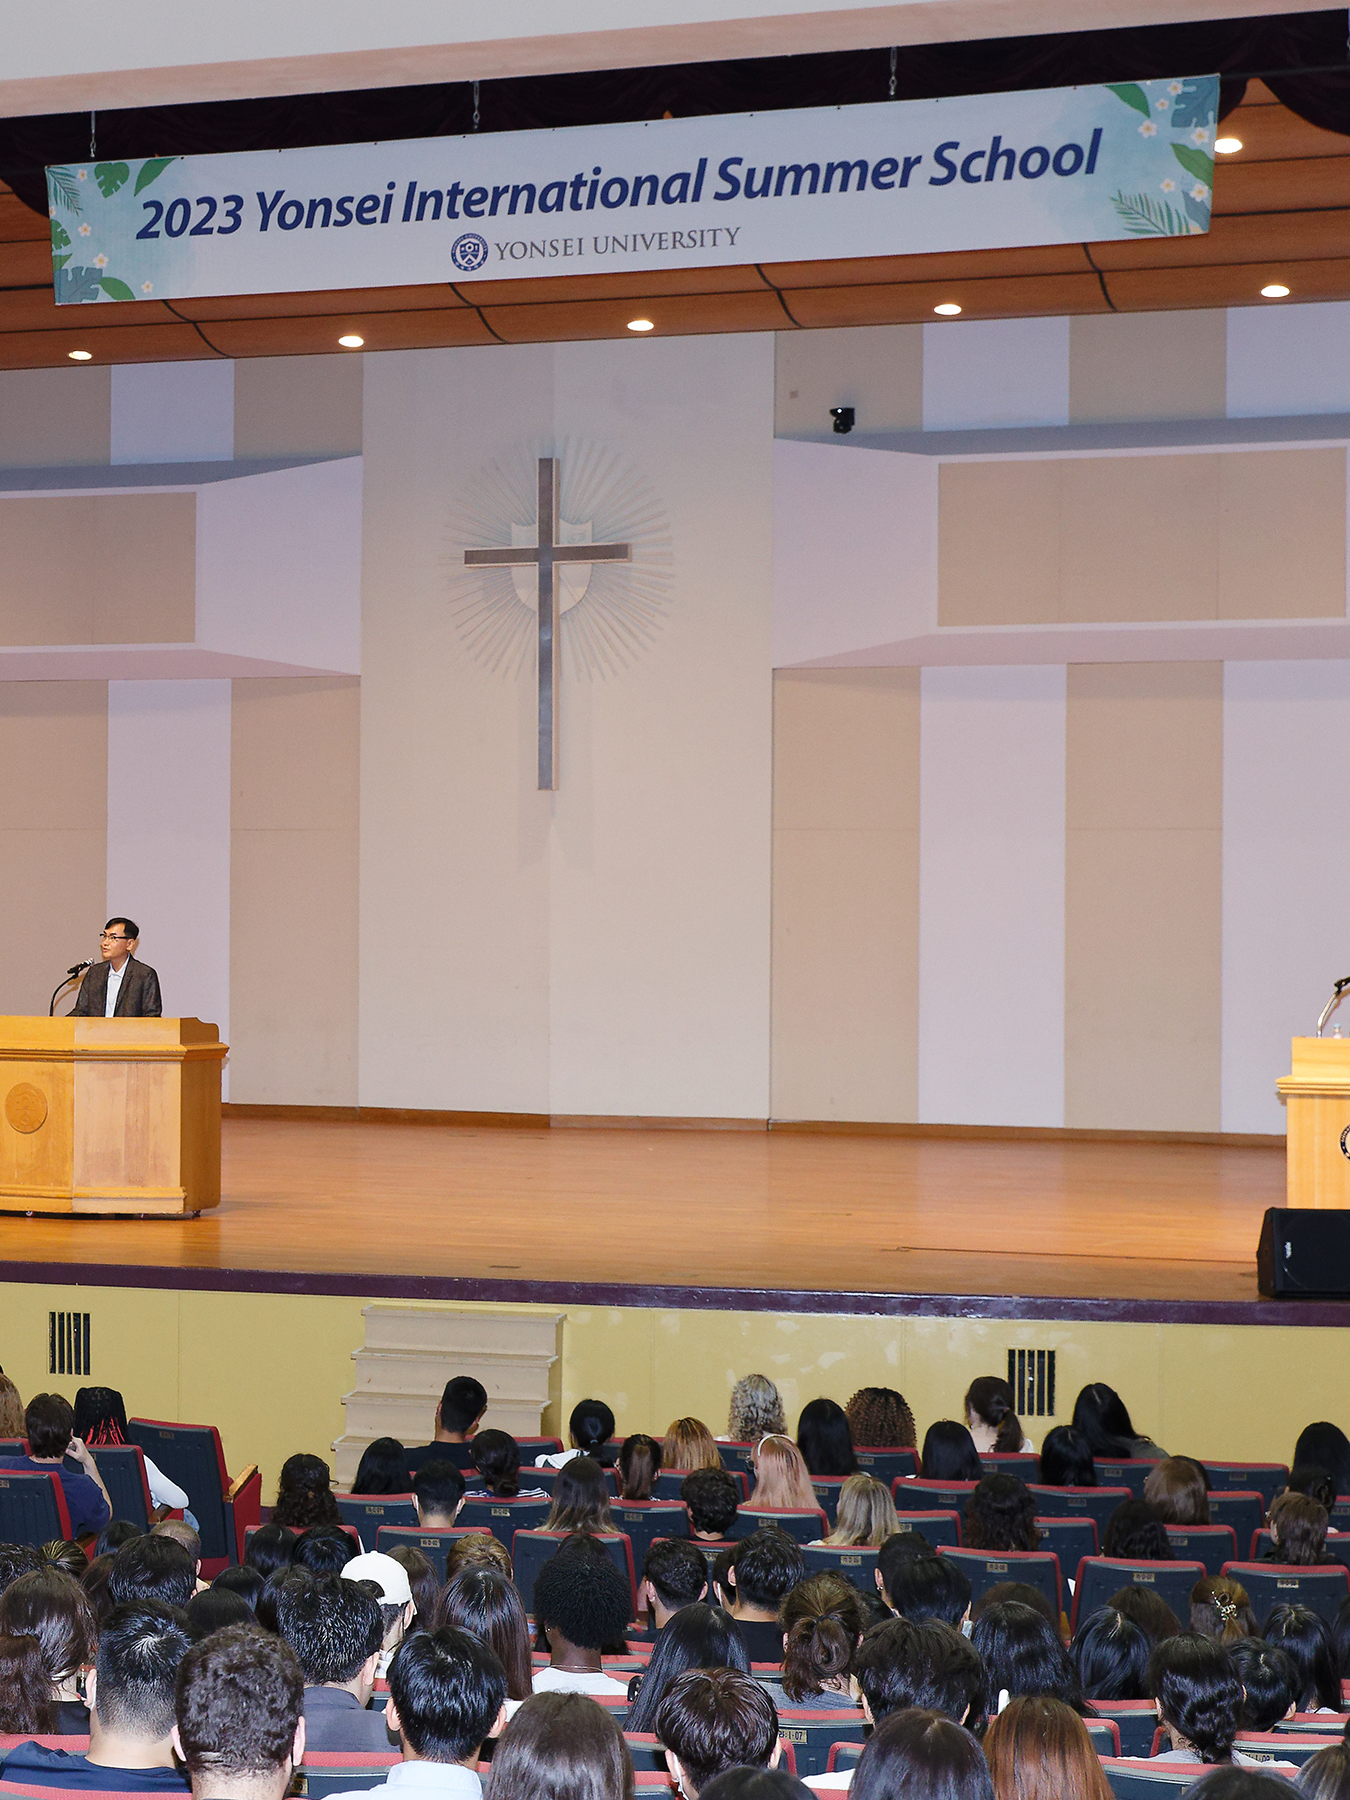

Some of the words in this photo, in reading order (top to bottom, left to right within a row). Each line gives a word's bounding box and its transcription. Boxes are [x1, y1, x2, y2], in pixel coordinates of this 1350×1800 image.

[135, 194, 244, 240] 2023
[256, 181, 395, 233] Yonsei
[401, 158, 708, 223] International
[712, 153, 925, 201] Summer
[927, 127, 1103, 187] School
[494, 237, 585, 261] YONSEI
[592, 226, 742, 255] UNIVERSITY
